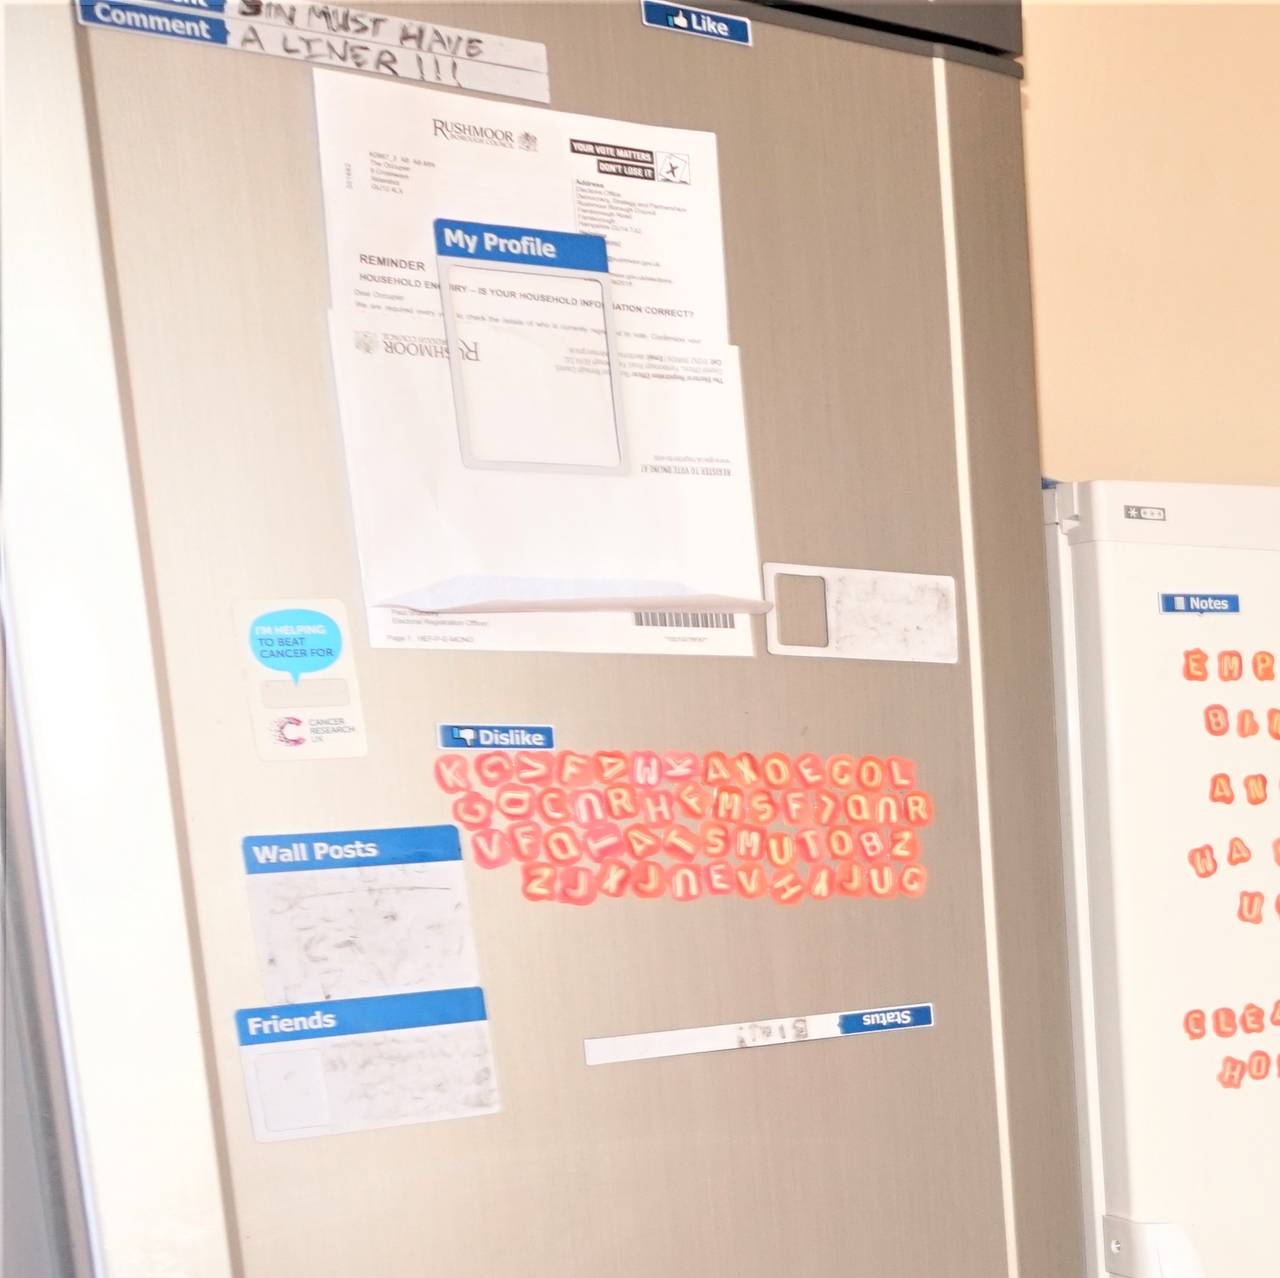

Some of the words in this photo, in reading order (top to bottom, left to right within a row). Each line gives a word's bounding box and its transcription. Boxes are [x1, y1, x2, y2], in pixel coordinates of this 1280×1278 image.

[94, 2, 211, 40] Comment
[308, 4, 388, 37] MUST
[400, 23, 484, 57] HAVE
[691, 13, 728, 36] Like
[241, 26, 264, 50] A
[282, 38, 400, 77] LINER
[433, 119, 514, 143] RUSHMOOR
[444, 229, 478, 254] My
[484, 233, 556, 259] Profile
[360, 254, 425, 271] REMINDER
[360, 273, 421, 288] HOUSEHOLD
[490, 289, 517, 299] YOUR
[520, 293, 577, 306] HOUSEHOLD
[645, 306, 694, 319] CORRECT?
[1190, 596, 1229, 610] Notes
[257, 637, 274, 647] TO
[277, 636, 305, 647] BEAT
[260, 648, 307, 659] CANCER
[310, 648, 334, 657] FOR
[480, 729, 545, 748] Dislike
[252, 841, 308, 864] Wall
[314, 840, 379, 862] Posts
[247, 1011, 337, 1035] Friends
[862, 1010, 911, 1027] Status
